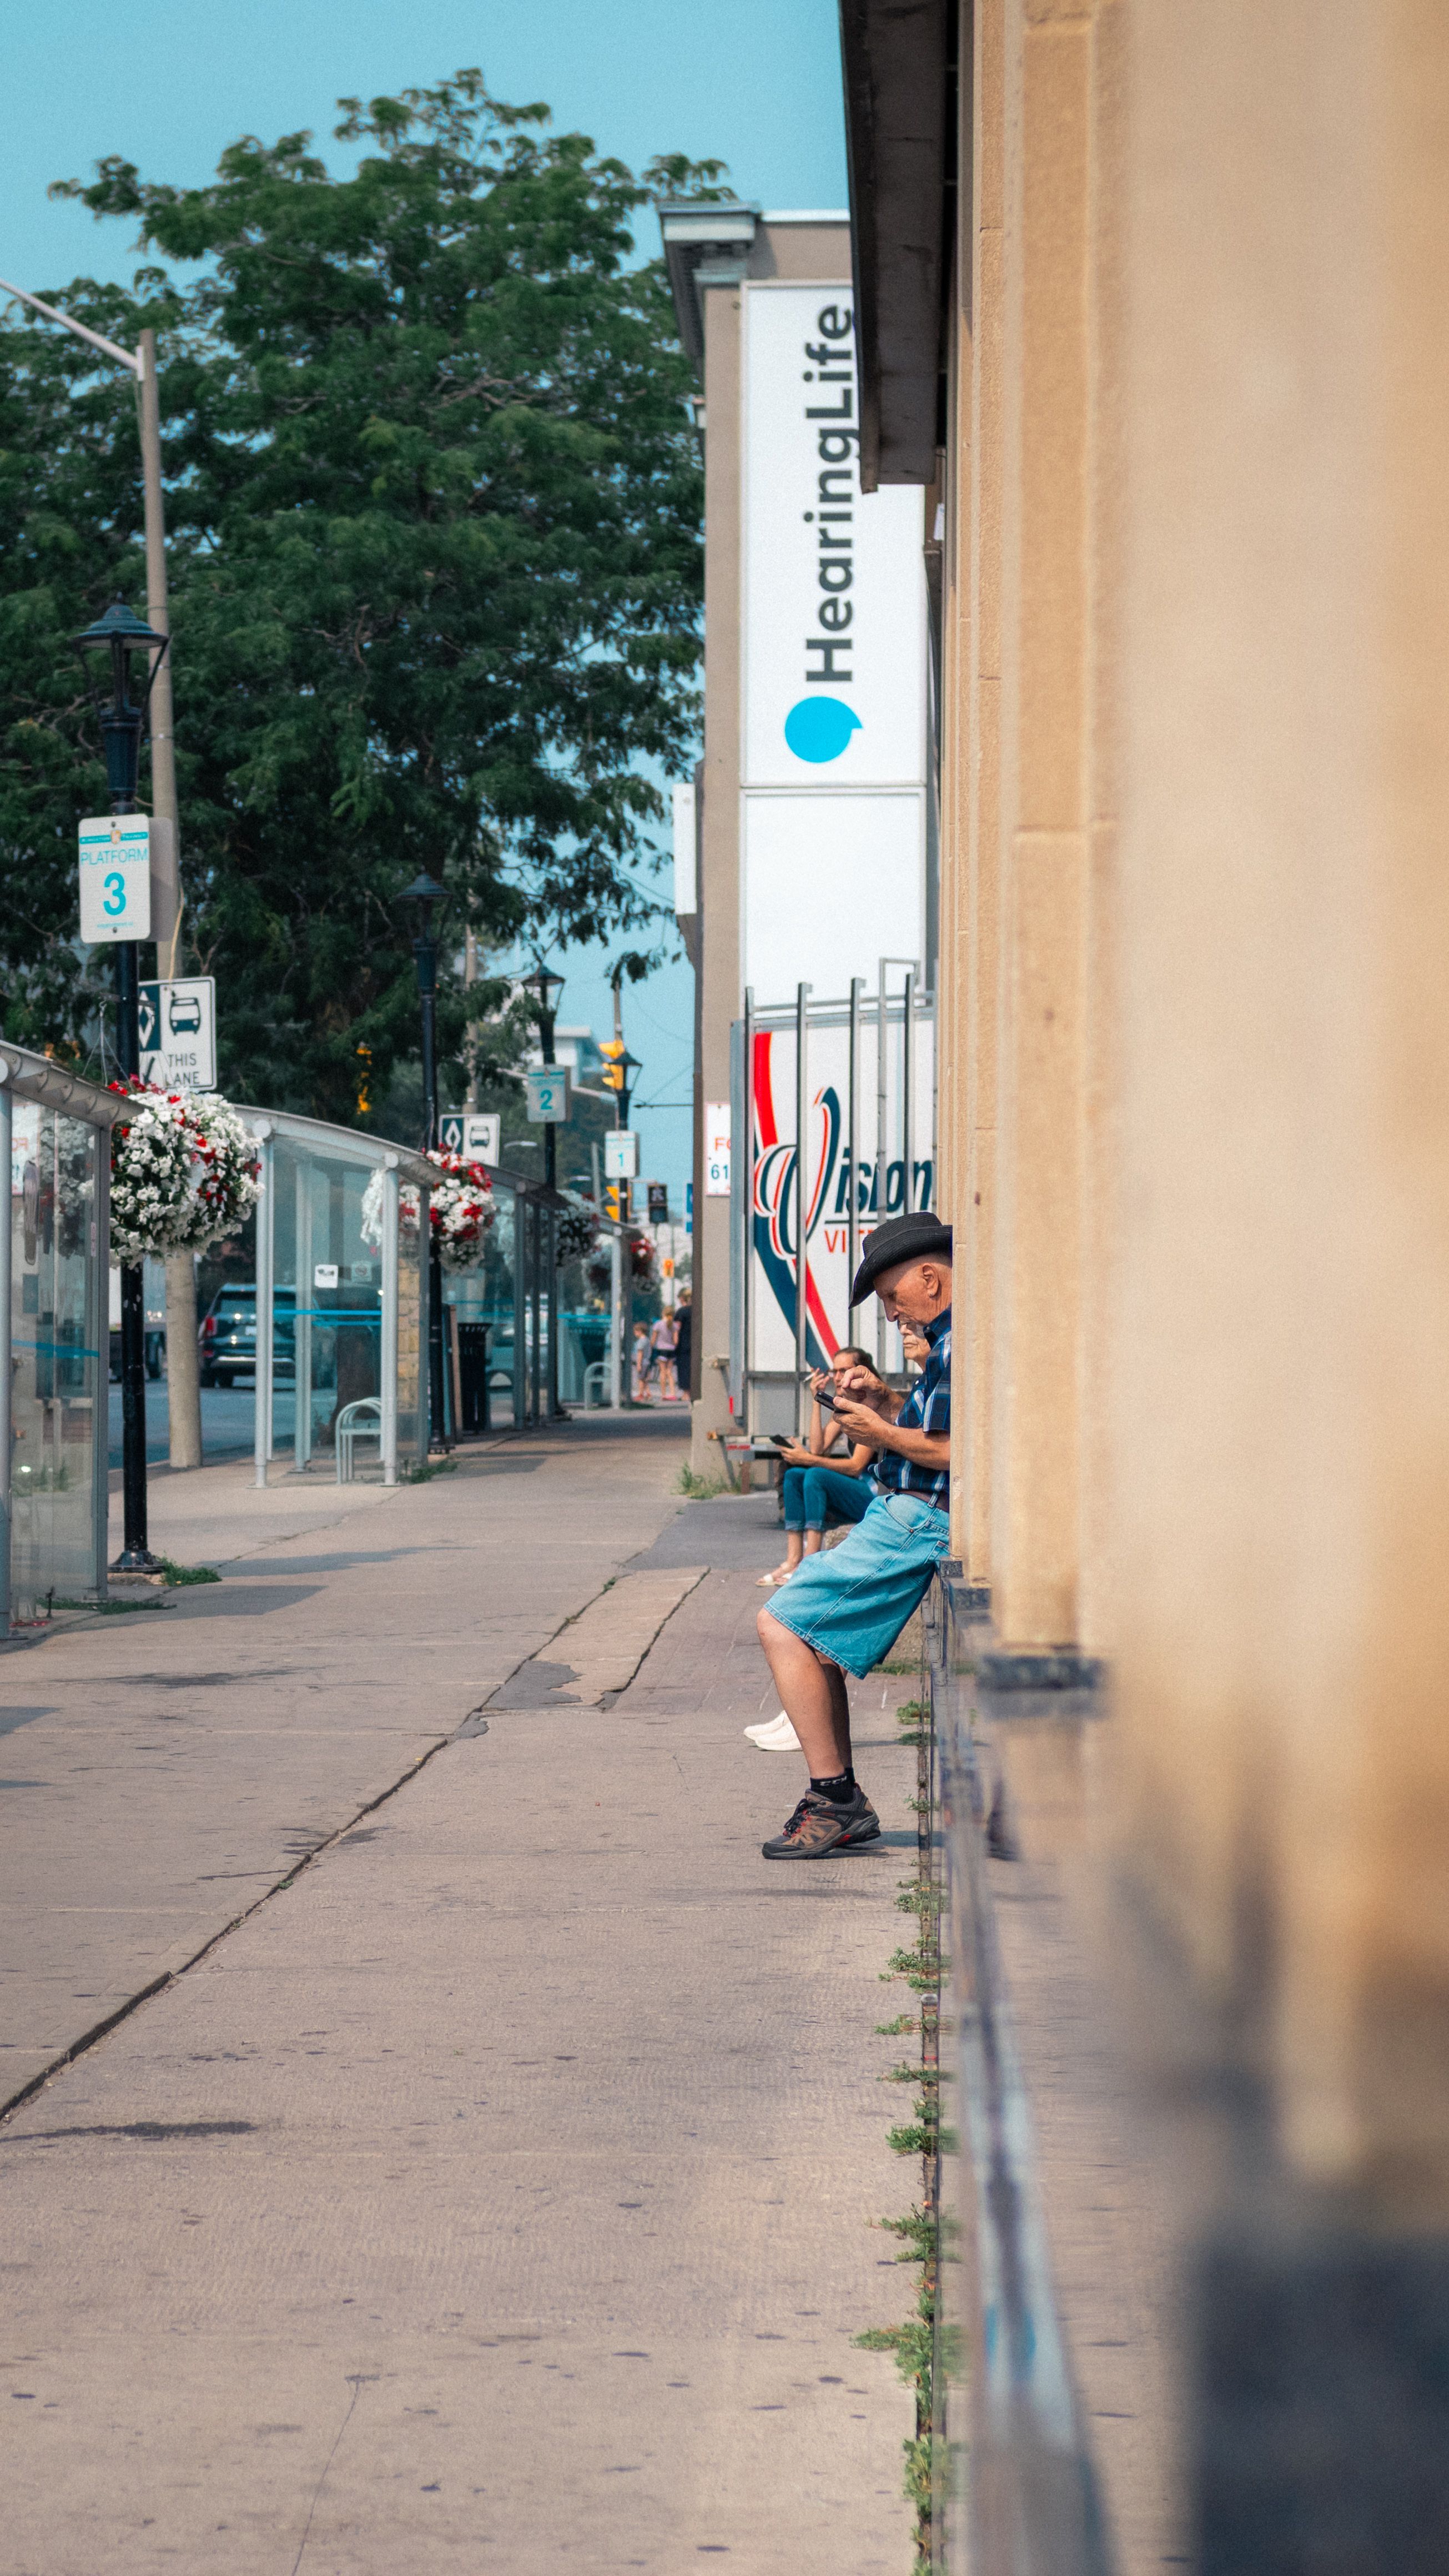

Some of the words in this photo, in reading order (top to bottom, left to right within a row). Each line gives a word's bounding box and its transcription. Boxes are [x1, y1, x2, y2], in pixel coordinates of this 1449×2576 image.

[803, 305, 860, 682] HearingLife
[80, 848, 148, 865] PLATFORM
[103, 872, 126, 915] 3
[168, 1053, 197, 1066] THIS
[165, 1071, 200, 1086] LANE
[540, 1089, 552, 1109] 2
[618, 1152, 623, 1166] 1
